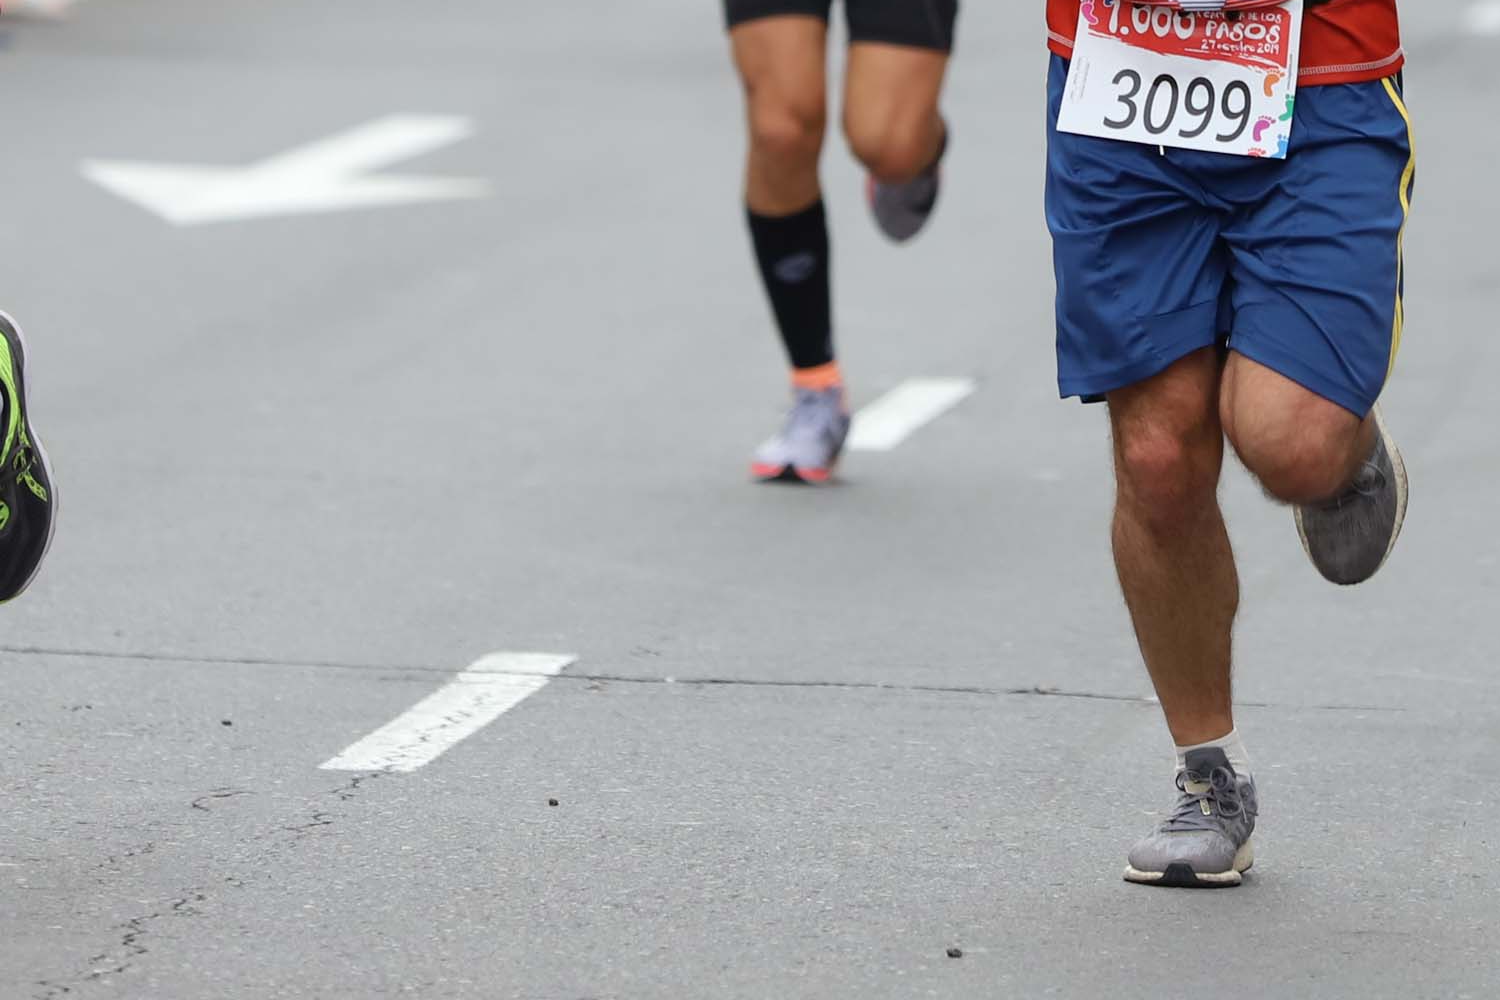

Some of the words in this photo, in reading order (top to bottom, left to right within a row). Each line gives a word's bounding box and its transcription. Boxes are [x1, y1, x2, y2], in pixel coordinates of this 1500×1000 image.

[1261, 12, 1282, 24] LOS
[1205, 20, 1281, 44] PASOS
[1201, 38, 1216, 50] 27
[1256, 42, 1280, 55] 2019
[1103, 68, 1251, 143] 3099
